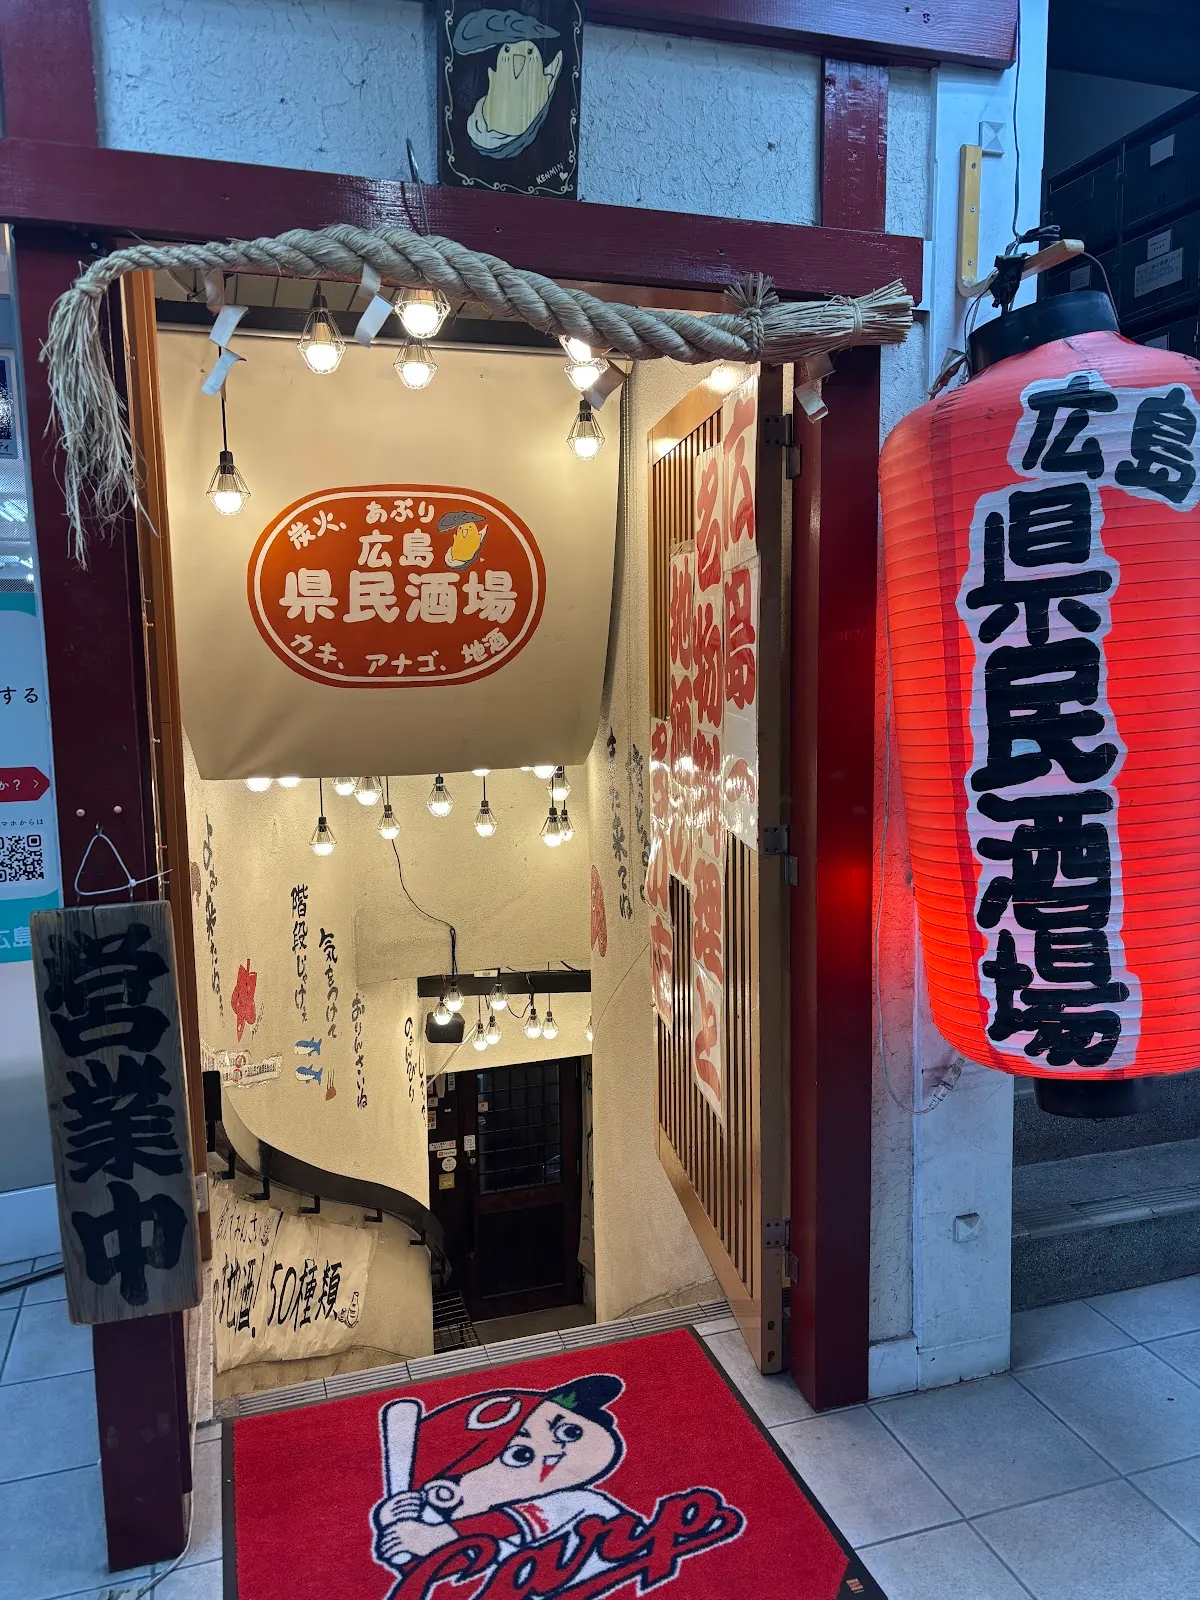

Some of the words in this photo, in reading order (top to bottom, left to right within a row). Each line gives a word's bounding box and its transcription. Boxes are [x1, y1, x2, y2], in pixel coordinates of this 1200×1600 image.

[536, 163, 564, 184] KENMIN
[1021, 375, 1198, 503] 広島
[365, 498, 435, 524] あぶり
[357, 528, 435, 568] 広島
[279, 567, 518, 624] 県民酒場
[290, 634, 344, 669] カキ、
[365, 650, 447, 674] アナゴ、
[461, 628, 510, 664] 地酒
[0, 686, 39, 705] する
[965, 488, 1129, 1069] 県民酒場
[318, 927, 339, 1039] 気をつけて
[43, 922, 188, 1307] 営業中
[383, 1486, 748, 1600] Carp
